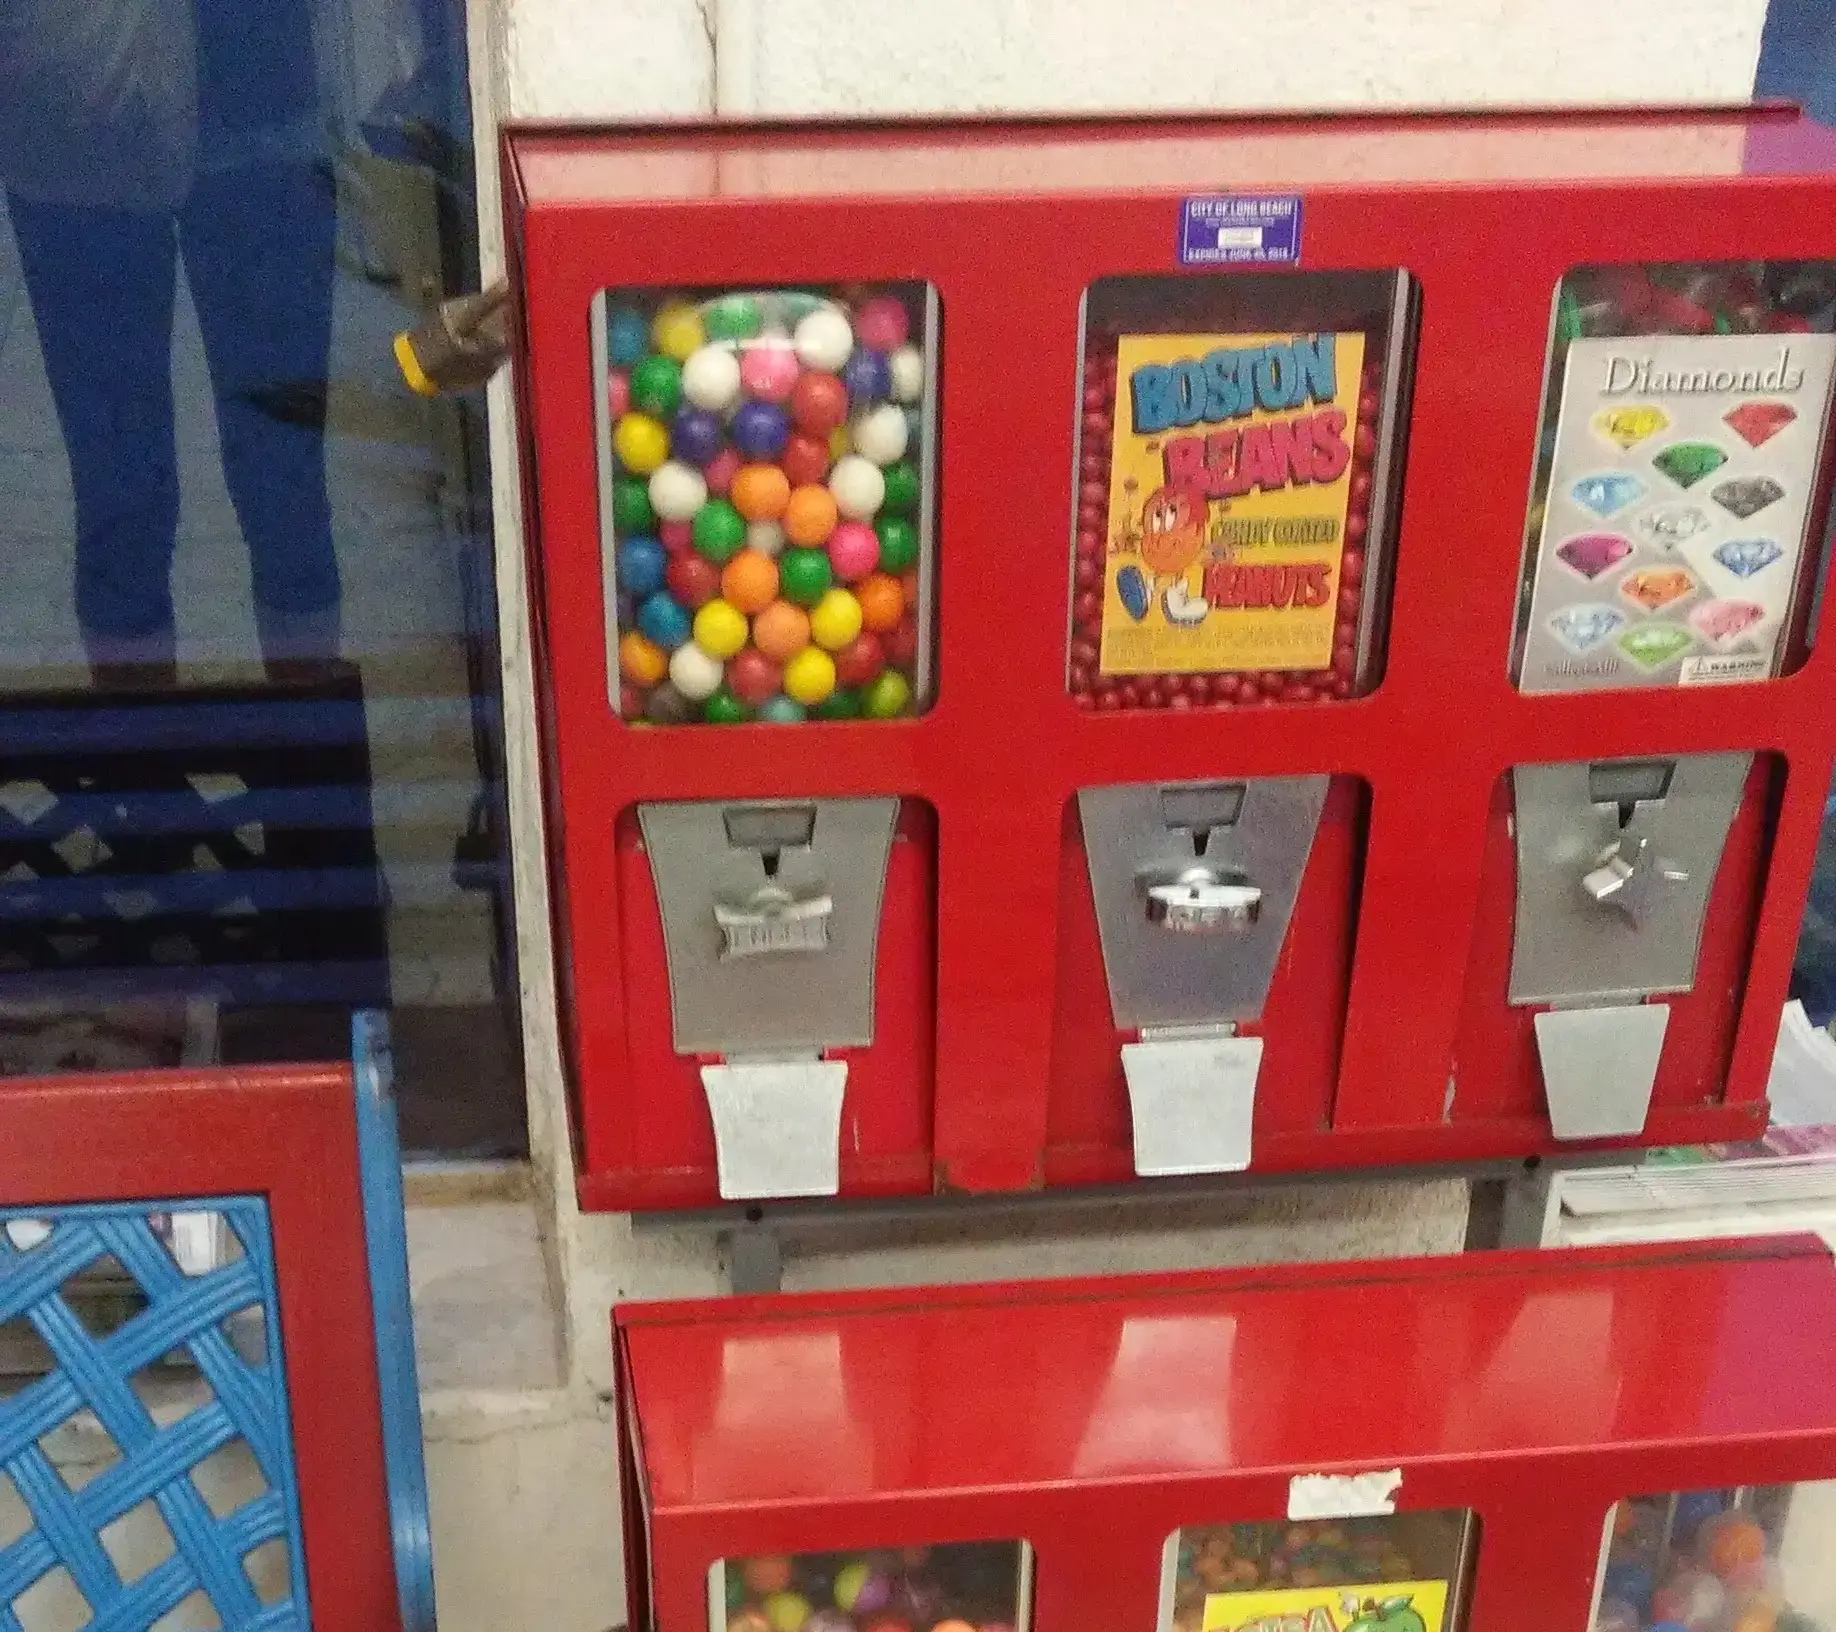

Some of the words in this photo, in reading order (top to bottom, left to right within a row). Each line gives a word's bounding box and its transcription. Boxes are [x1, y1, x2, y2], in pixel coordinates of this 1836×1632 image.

[1131, 331, 1338, 434] BOSTON
[1601, 347, 1805, 394] Diamonds
[1163, 408, 1351, 501] BEANS
[1203, 562, 1332, 609] PEANUTS
